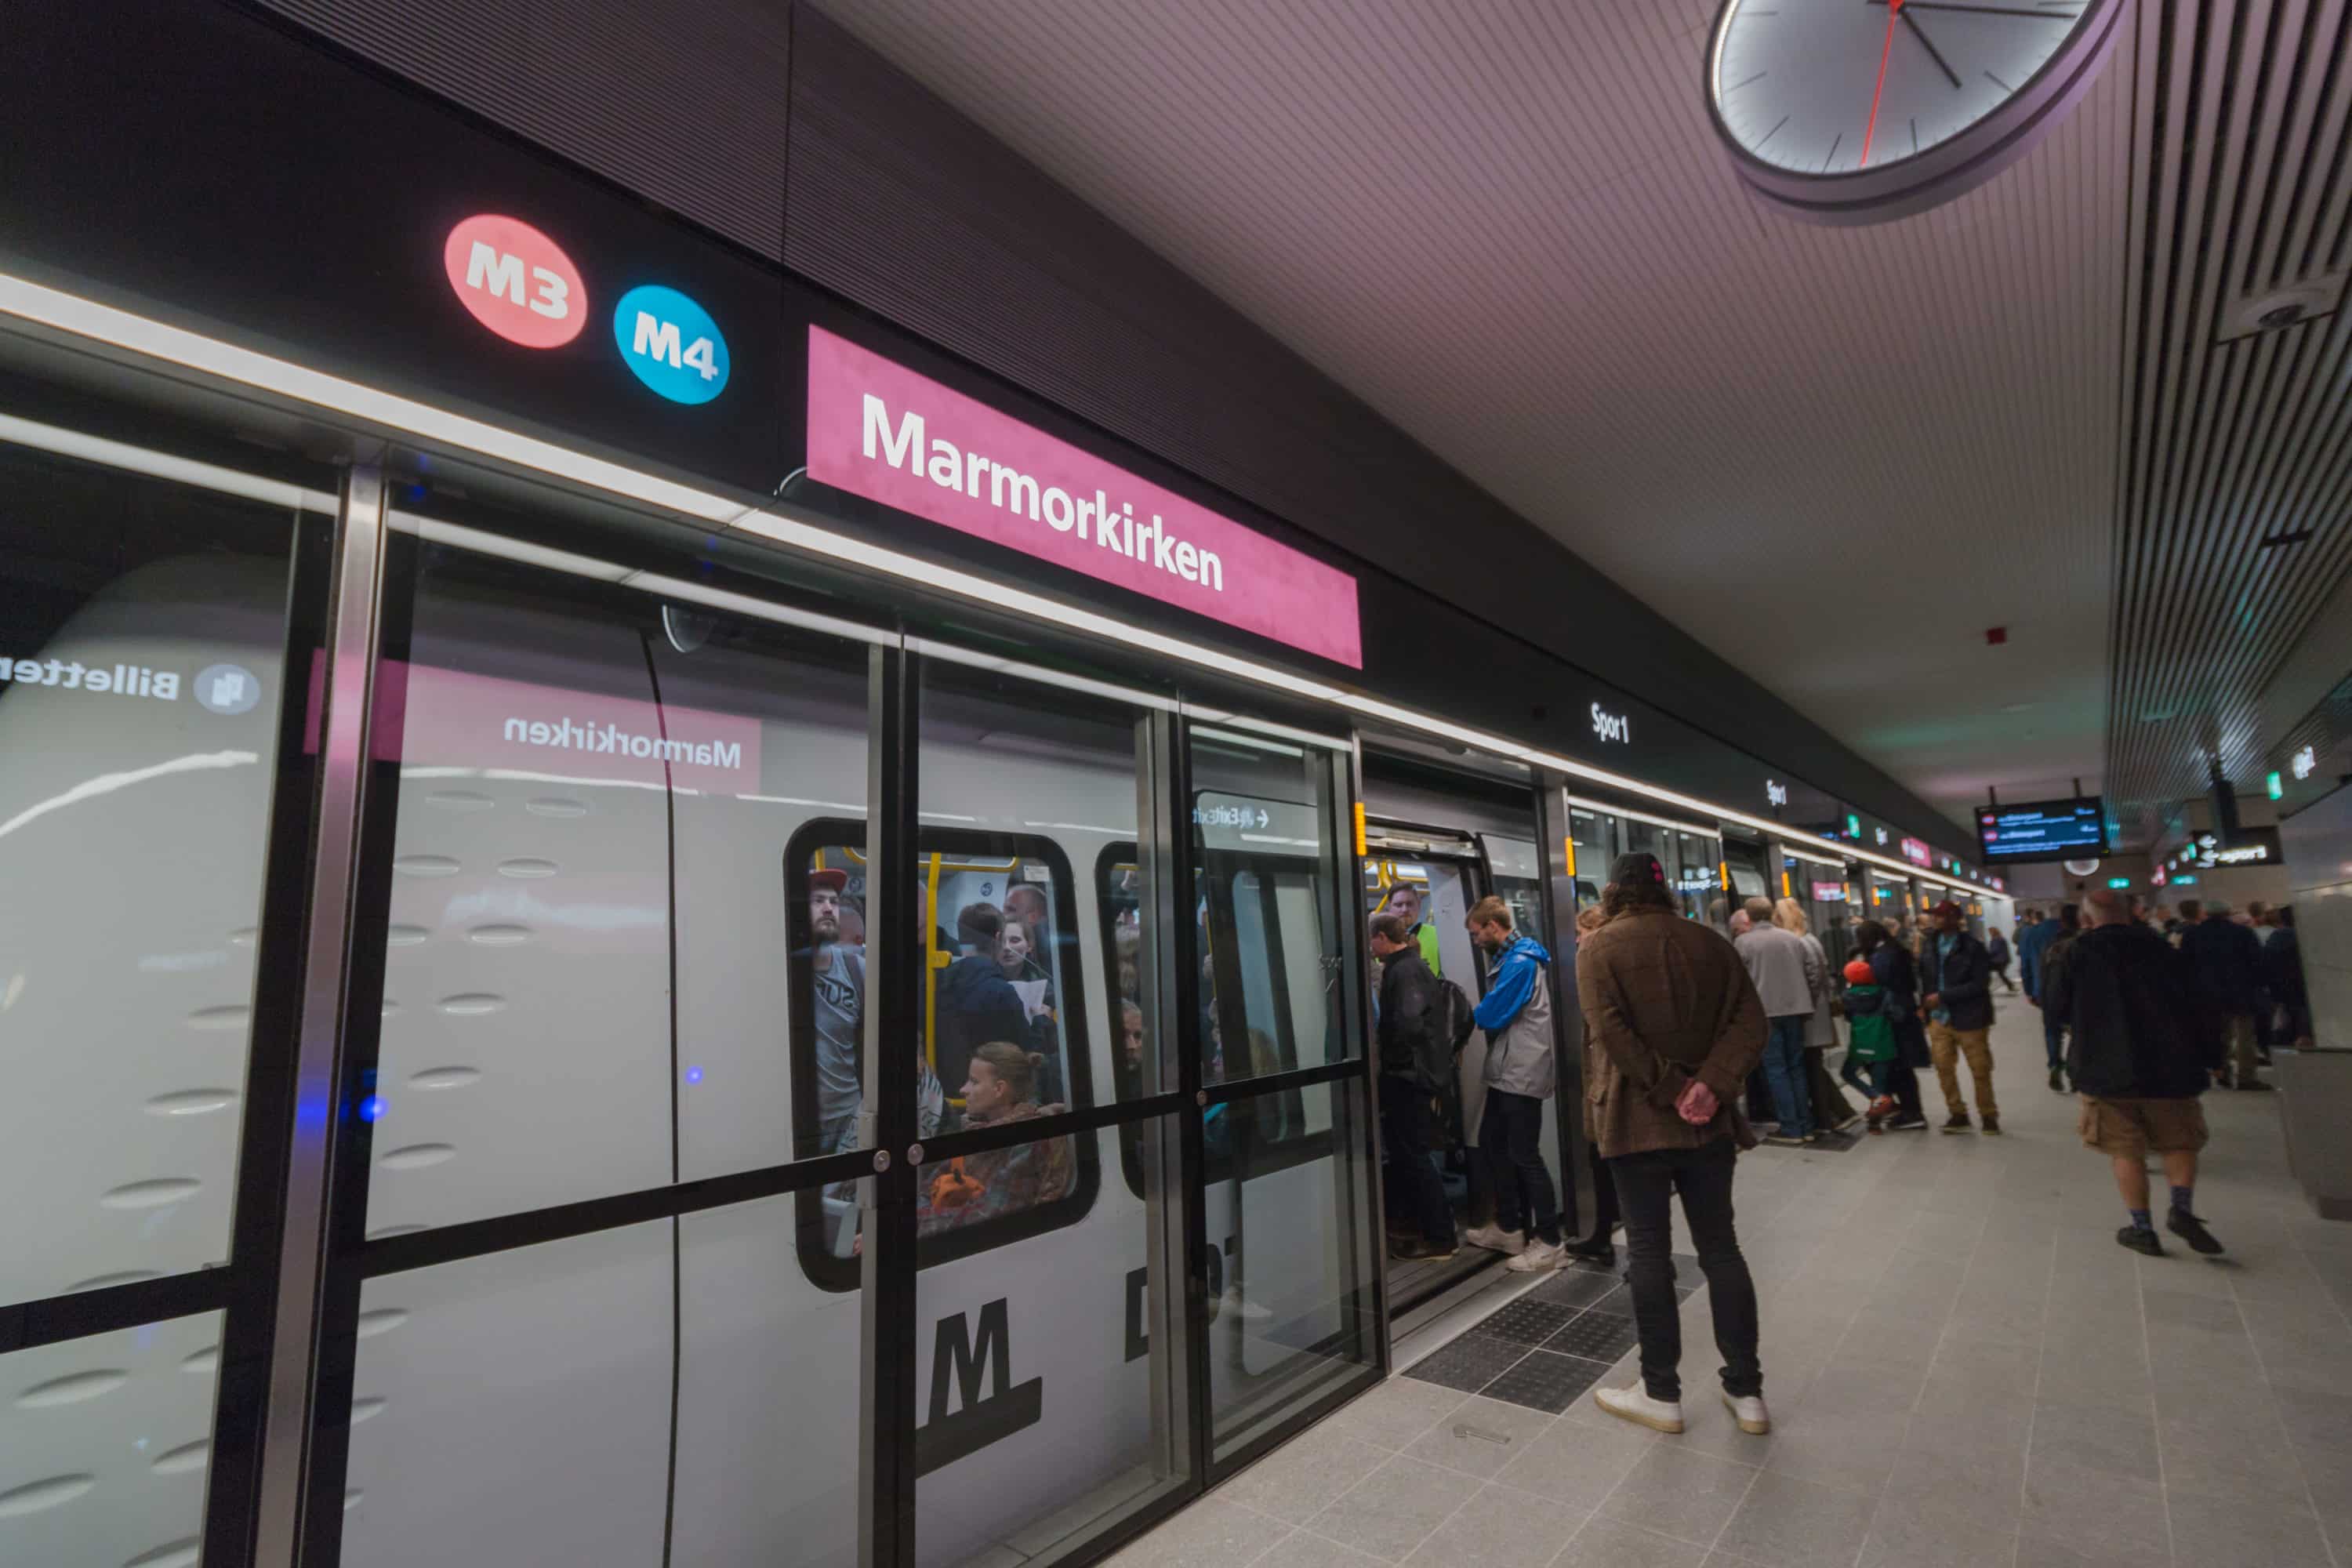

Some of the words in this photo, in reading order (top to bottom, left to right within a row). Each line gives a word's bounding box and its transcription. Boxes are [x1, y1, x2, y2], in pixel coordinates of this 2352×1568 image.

[466, 241, 568, 319] M3
[633, 310, 719, 382] M4
[862, 392, 1223, 592] Marmorkirken
